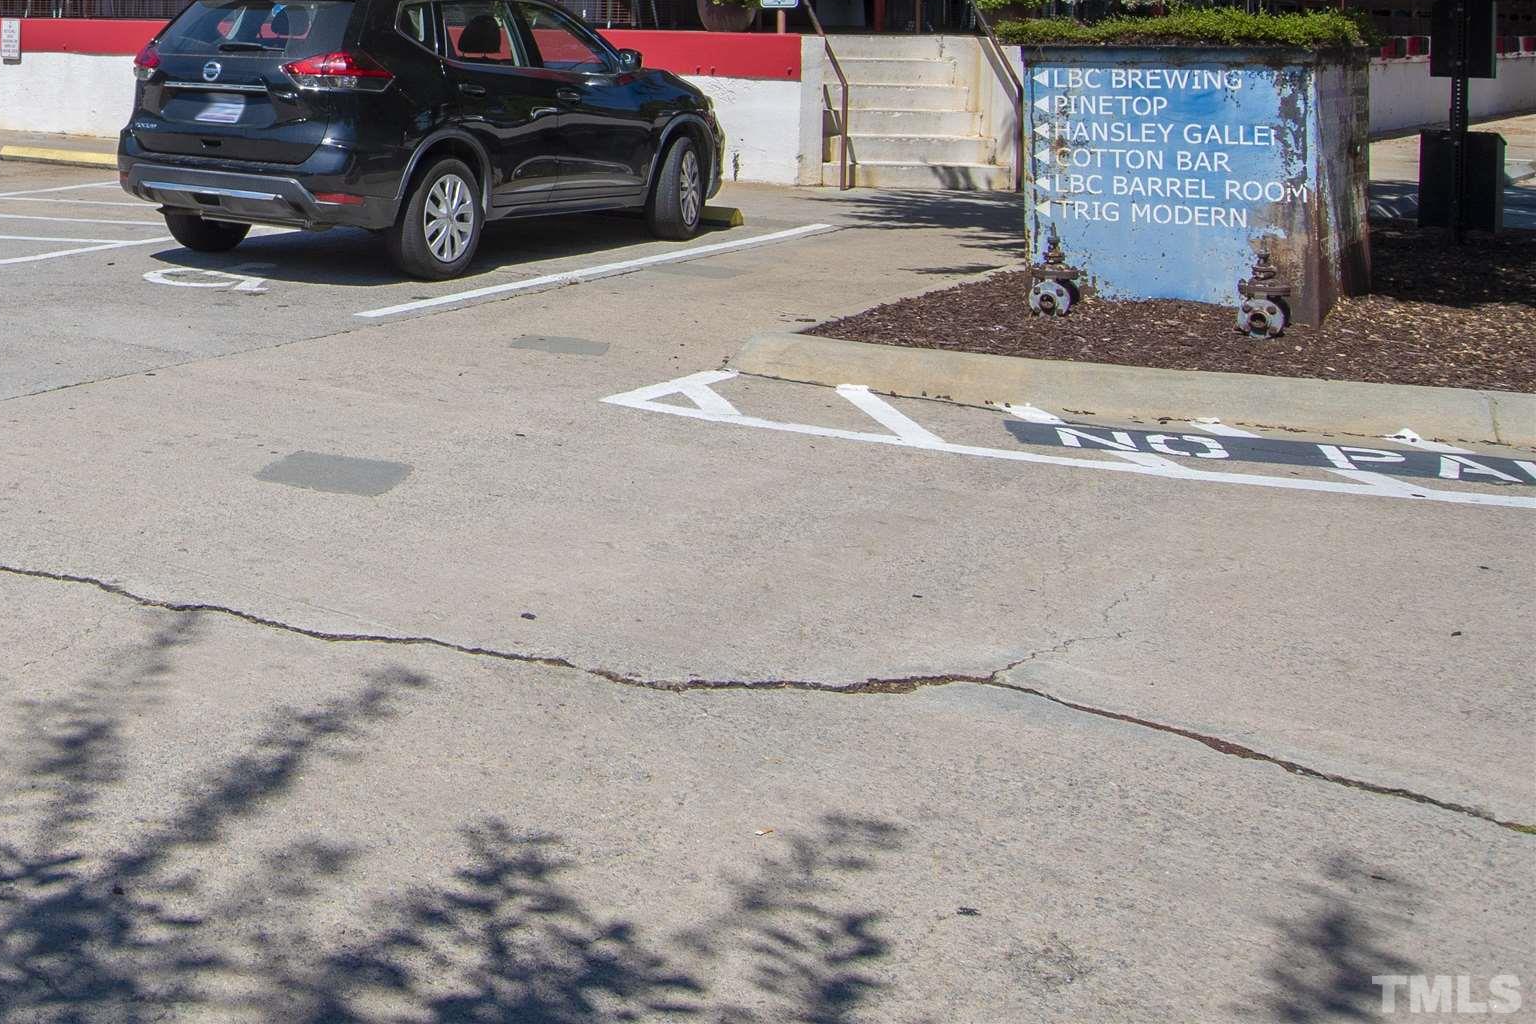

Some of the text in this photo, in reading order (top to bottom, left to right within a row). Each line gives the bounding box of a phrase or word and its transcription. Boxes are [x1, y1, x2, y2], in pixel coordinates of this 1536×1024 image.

[1053, 68, 1243, 90] LBC BREWING
[1054, 95, 1168, 116] PINETOP
[1054, 121, 1175, 143] HANSLEY
[1055, 147, 1232, 172] COTTON BAR
[1054, 173, 1308, 203] LBC BARREL ROOM
[1055, 200, 1248, 228] TRIG MODERN
[1055, 426, 1536, 485] NO PA
